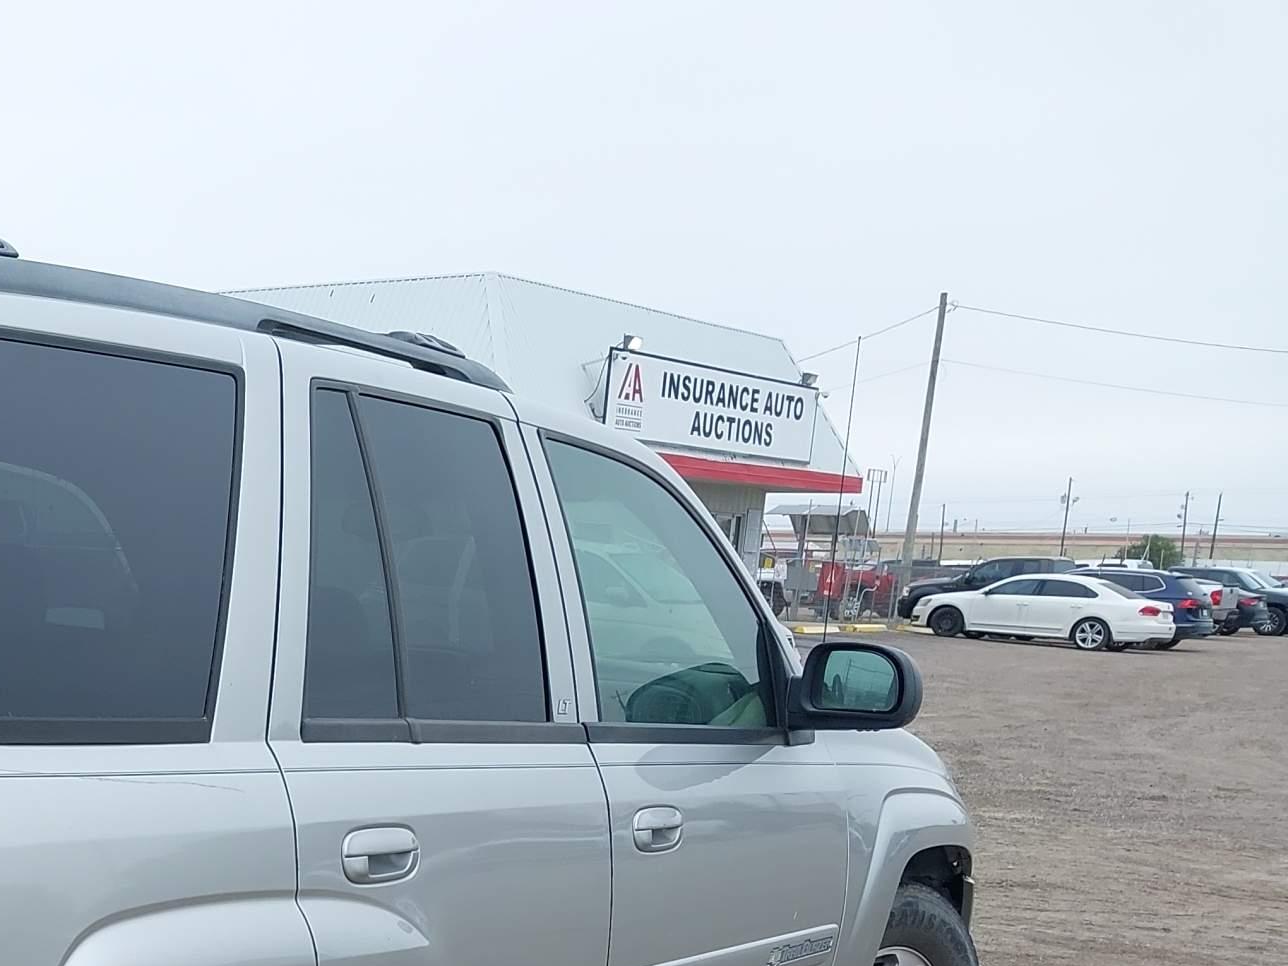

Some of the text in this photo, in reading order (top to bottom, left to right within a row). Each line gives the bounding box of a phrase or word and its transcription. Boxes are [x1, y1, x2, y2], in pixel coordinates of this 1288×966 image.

[661, 371, 804, 421] INSURANCE AUTO
[690, 411, 773, 447] AUCTIONS
